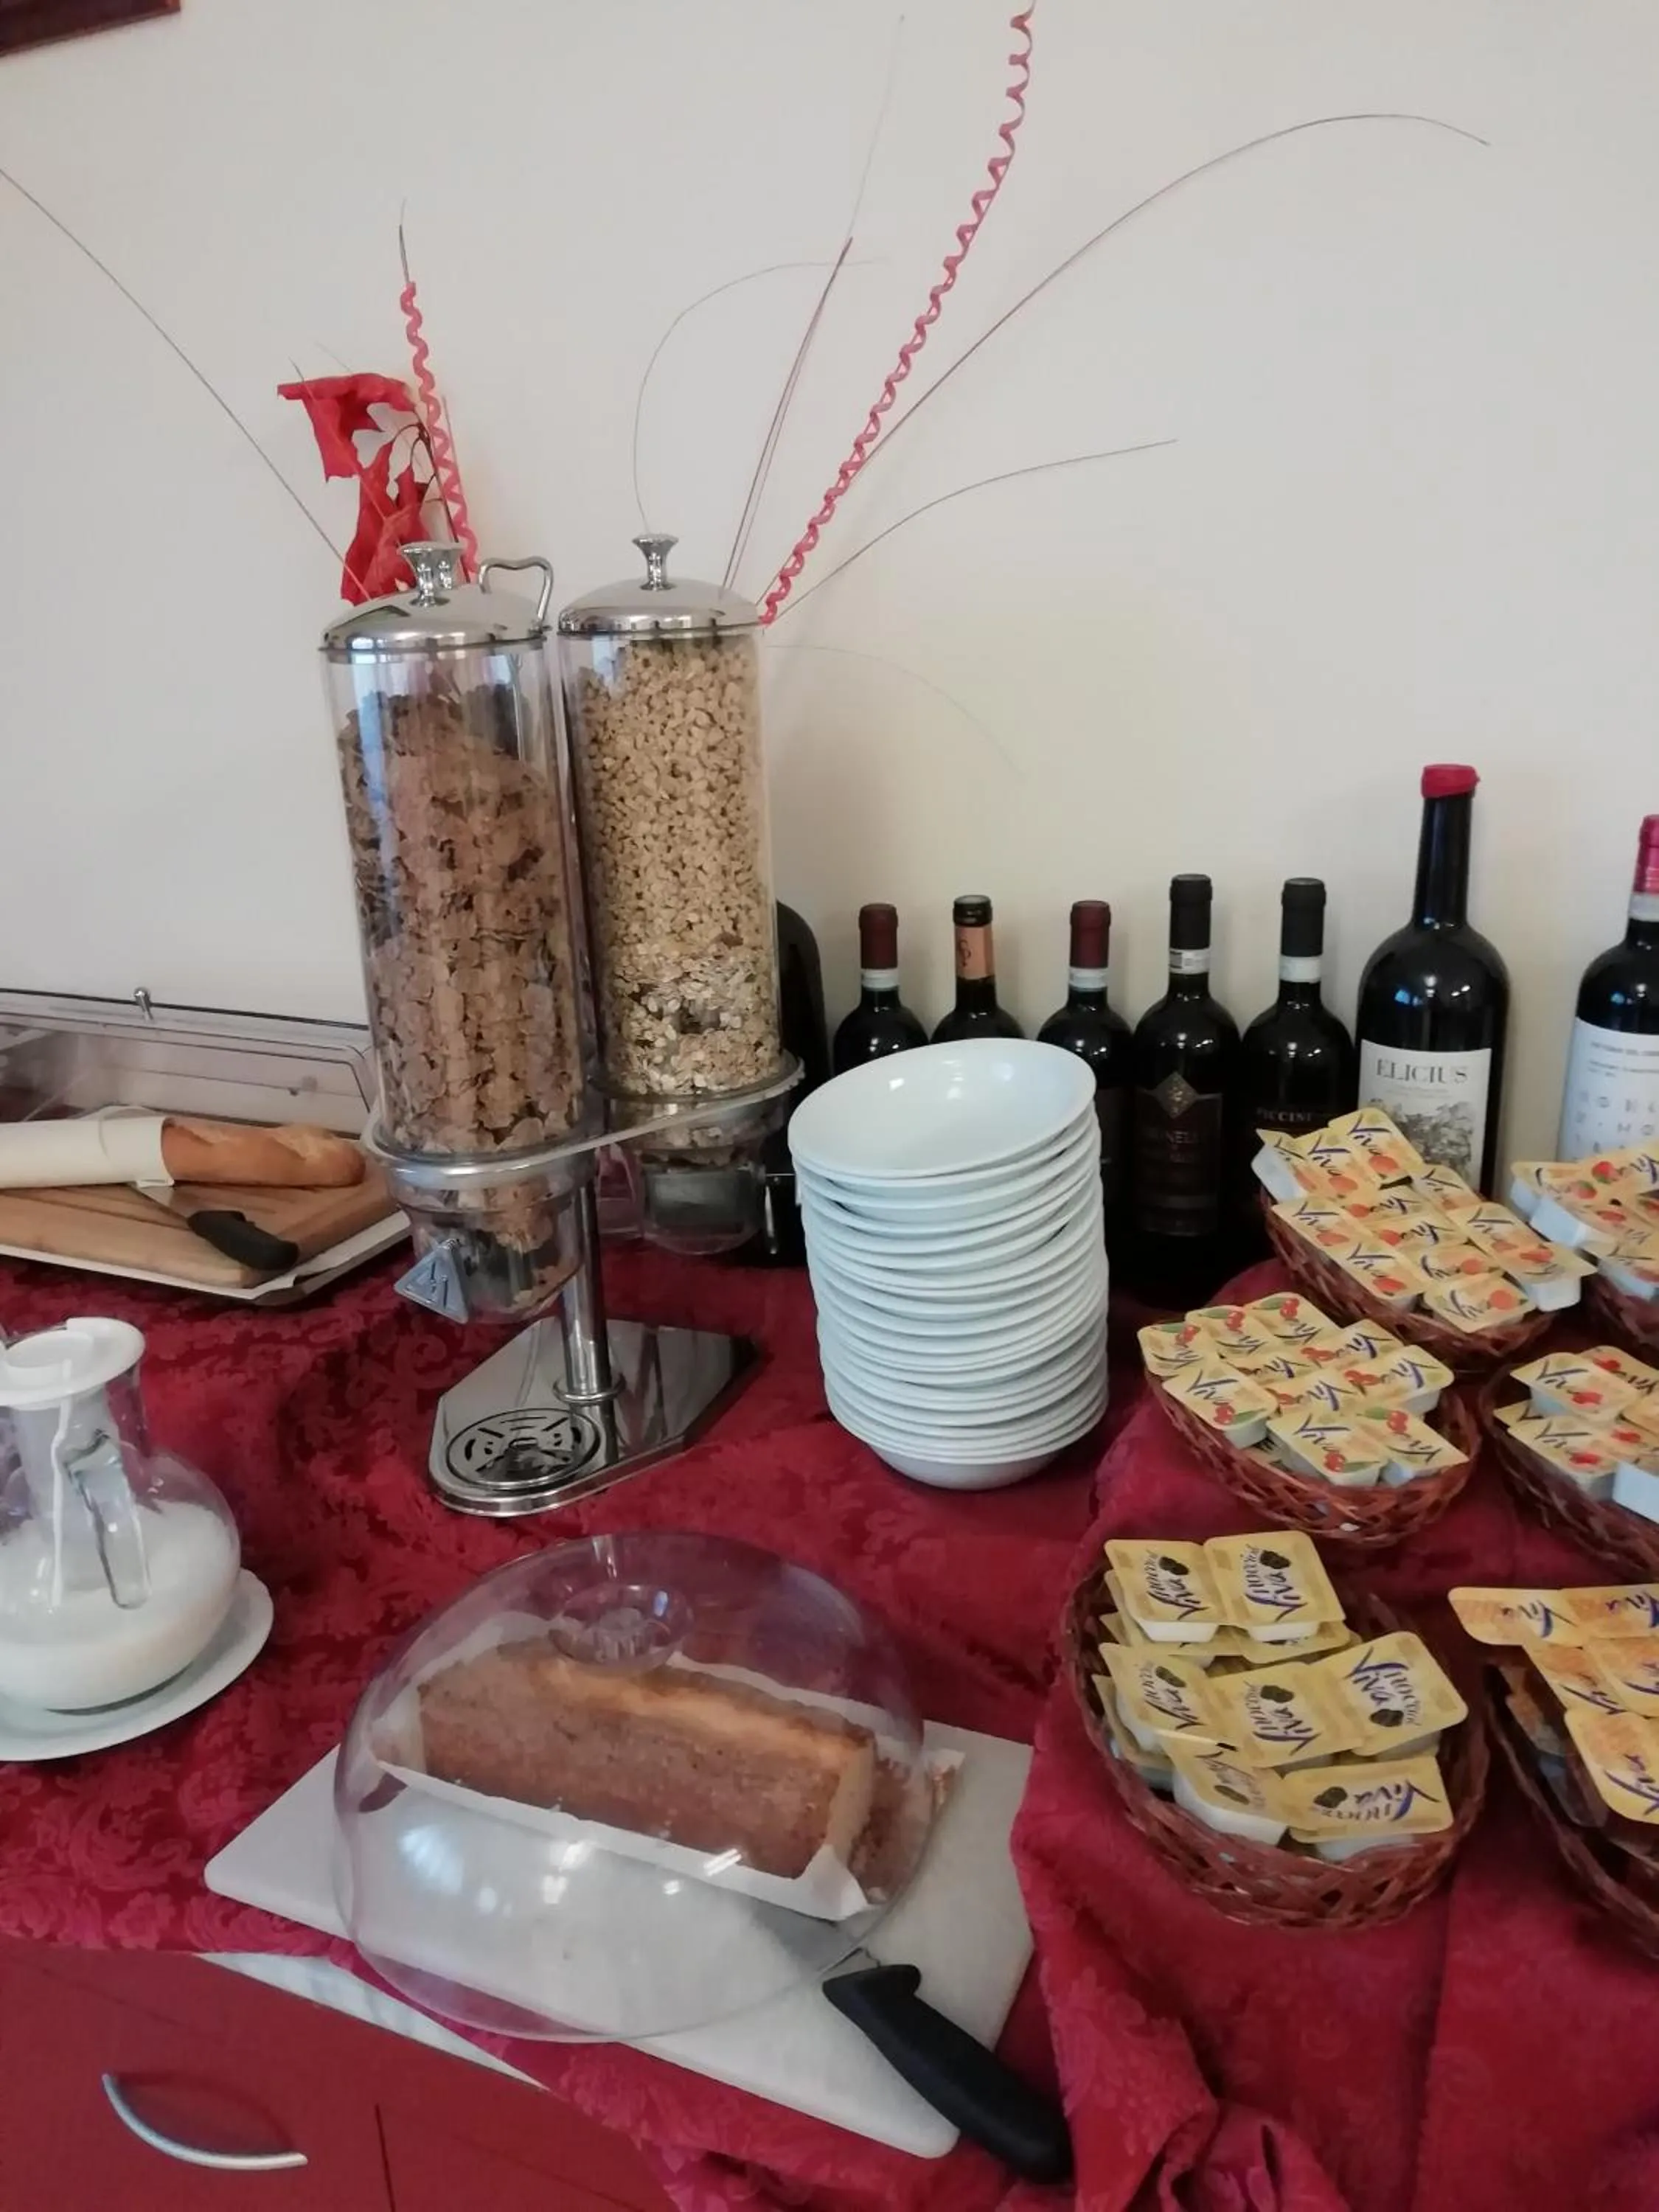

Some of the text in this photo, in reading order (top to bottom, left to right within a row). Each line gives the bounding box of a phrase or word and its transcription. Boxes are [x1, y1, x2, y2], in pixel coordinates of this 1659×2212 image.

[1147, 1578, 1211, 1620] Viva
[1244, 1571, 1308, 1621] Viva
[1344, 1646, 1409, 1703] Viva
[1251, 1707, 1322, 1756] Viva
[1354, 1779, 1440, 1821] Viva
